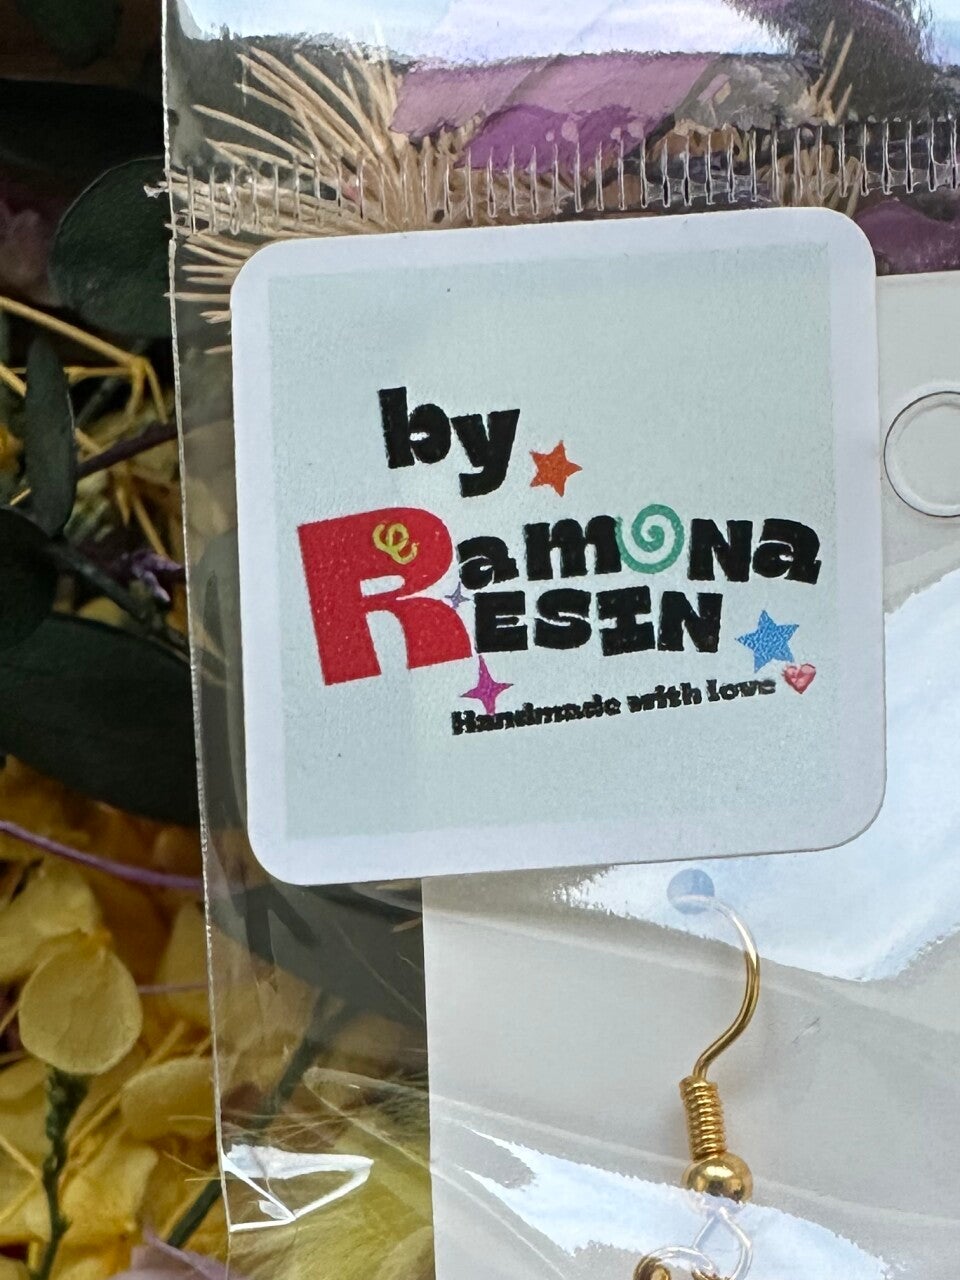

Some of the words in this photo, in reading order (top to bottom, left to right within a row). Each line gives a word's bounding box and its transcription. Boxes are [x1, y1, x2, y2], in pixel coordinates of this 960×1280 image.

[379, 387, 521, 497] by
[451, 694, 621, 736] Handmade
[626, 682, 702, 712] with
[706, 678, 777, 703] love
